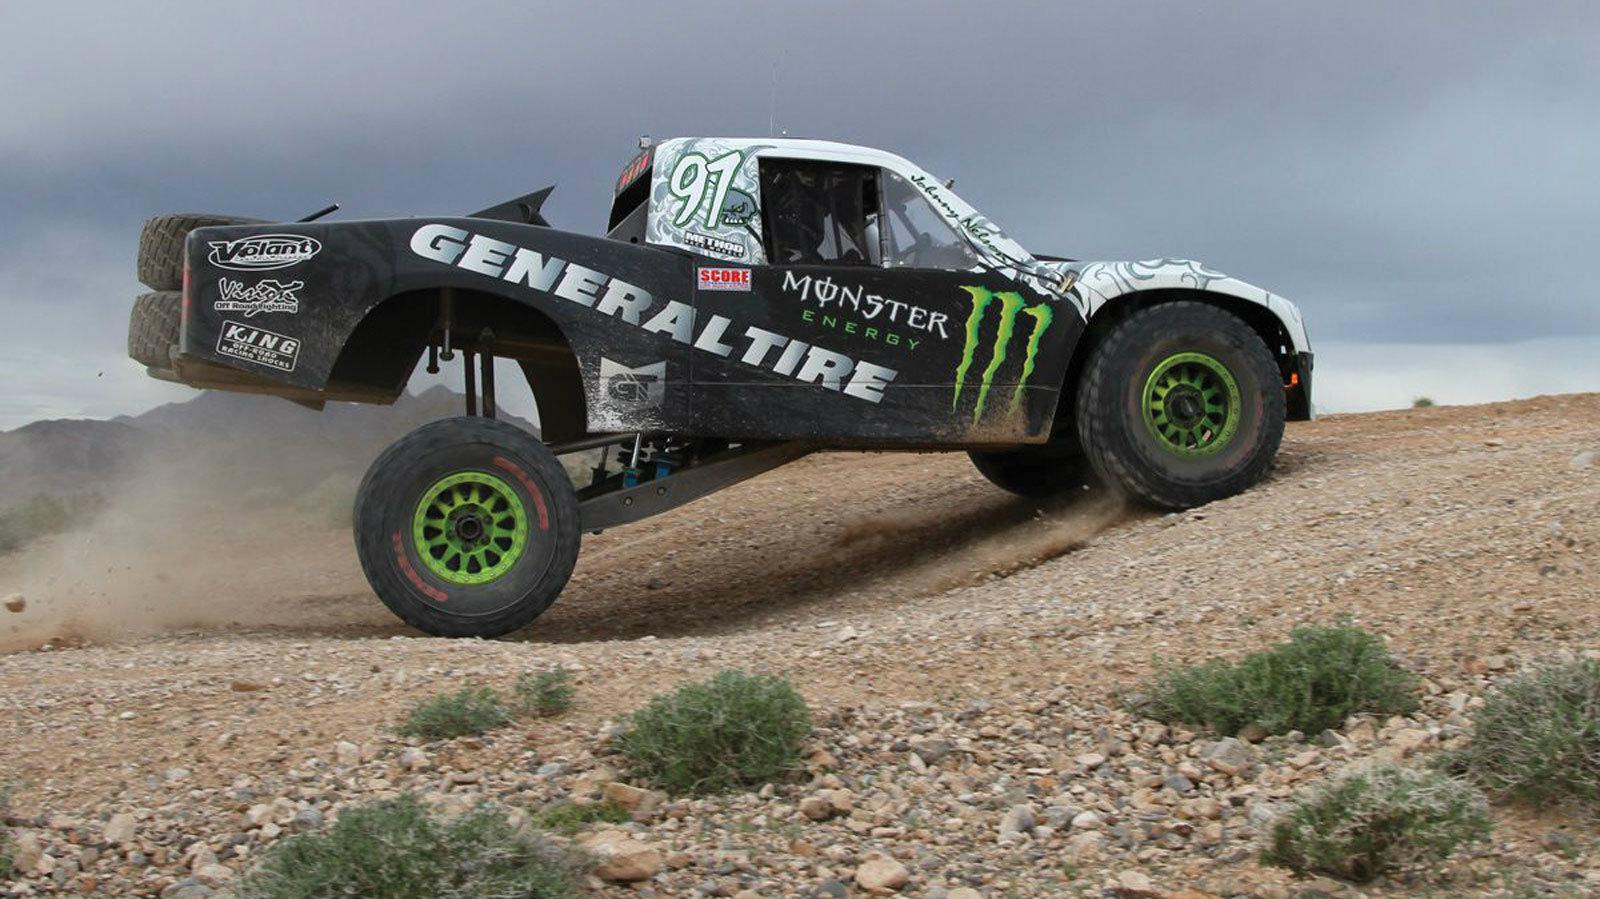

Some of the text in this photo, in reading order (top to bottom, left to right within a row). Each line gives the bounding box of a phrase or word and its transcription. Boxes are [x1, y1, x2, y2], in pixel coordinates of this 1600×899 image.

[669, 150, 745, 230] 91
[910, 174, 961, 219] Johnny
[207, 239, 315, 264] Volant
[685, 231, 745, 254] METHOD
[701, 269, 750, 283] SCORE
[225, 325, 298, 354] KING
[802, 309, 921, 351] ENERGY
[221, 345, 291, 369] RACING SHOCKS
